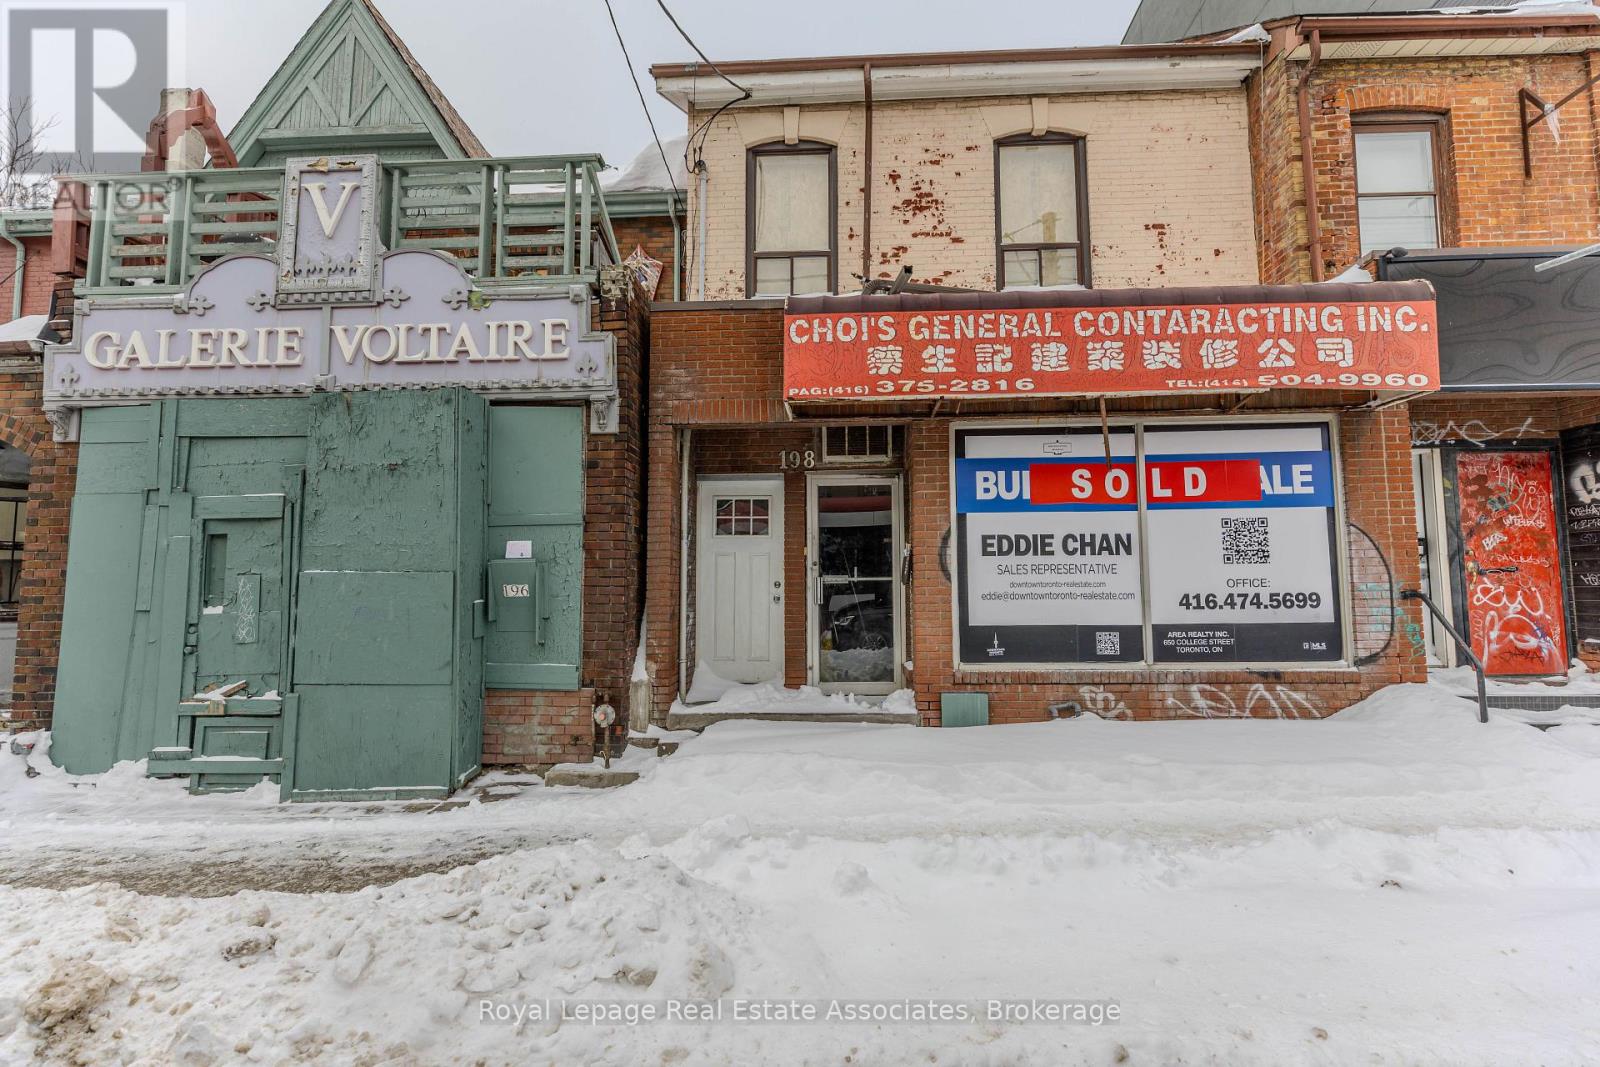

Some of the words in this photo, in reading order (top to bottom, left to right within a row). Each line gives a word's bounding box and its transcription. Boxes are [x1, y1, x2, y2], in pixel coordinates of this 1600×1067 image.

[301, 182, 360, 239] V
[789, 315, 896, 343] CHOI'S
[908, 312, 1062, 341] GENERAL
[1073, 306, 1343, 337] CONTARACTING
[1357, 305, 1429, 333] INC.
[84, 326, 305, 370] GALERIE
[330, 318, 571, 365] VOLTAIRE
[876, 378, 1036, 393] 375-2816
[1165, 378, 1249, 389] TEL:(416)
[1257, 373, 1429, 387] 504-9960
[779, 450, 815, 469] 198
[975, 470, 1030, 501] BUI
[1259, 463, 1315, 495] ALE
[981, 534, 1055, 557] EDDIE
[1062, 533, 1132, 556] CHAN
[997, 564, 1029, 575] SALES
[1031, 563, 1118, 575] REPRESENTATIVE
[503, 585, 529, 597] 196
[1226, 578, 1271, 588] OFFICE:
[981, 591, 1136, 601] eddie@downtowntoronto-realestate.com
[1178, 592, 1322, 610] 416.474.5699
